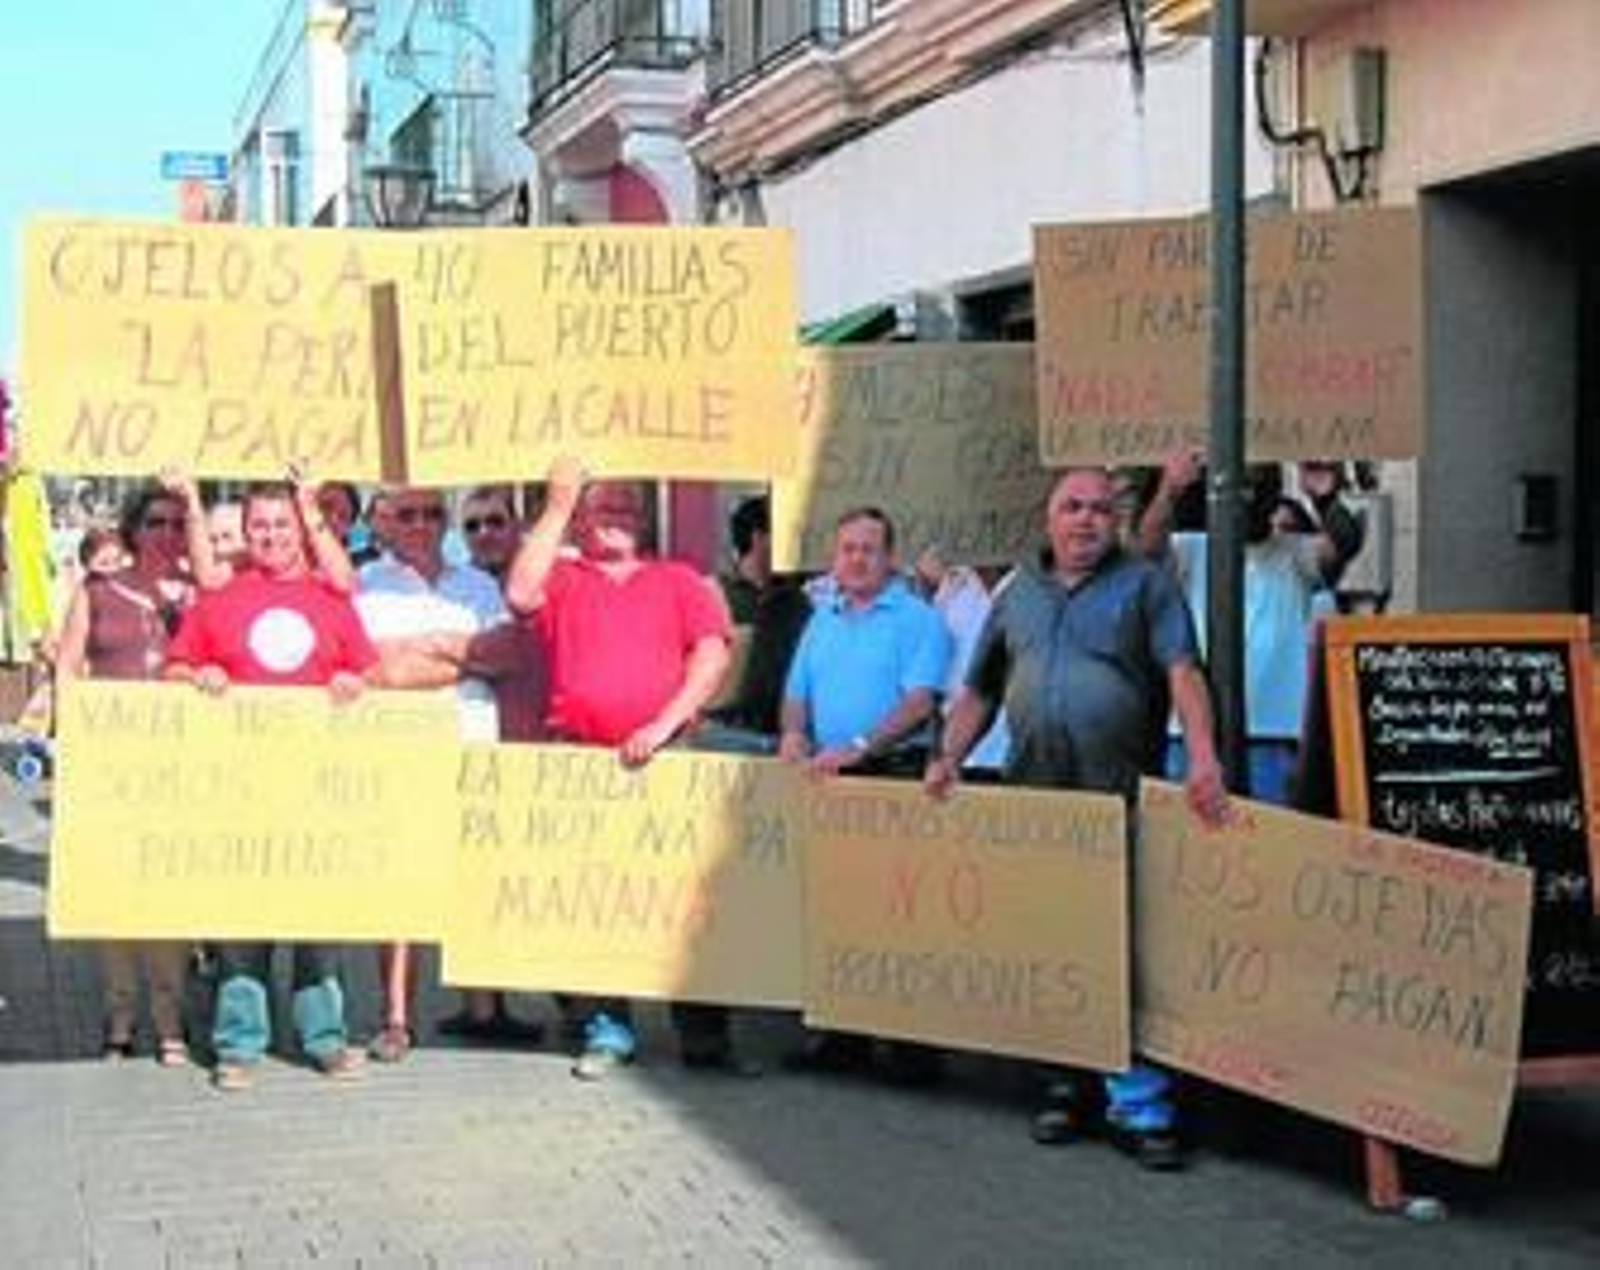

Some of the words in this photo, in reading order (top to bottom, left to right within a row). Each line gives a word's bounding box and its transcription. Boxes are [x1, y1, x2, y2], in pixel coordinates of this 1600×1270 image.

[540, 239, 753, 296] FAMILIAS
[416, 311, 534, 374] DEL
[555, 297, 739, 362] PUERTO
[64, 397, 158, 459] NO
[418, 394, 483, 451] EN
[508, 390, 563, 444] LA
[570, 384, 736, 445] CALLE
[455, 749, 502, 794] LA
[1191, 933, 1272, 1007] NO
[1327, 958, 1494, 1052] PAGAN
